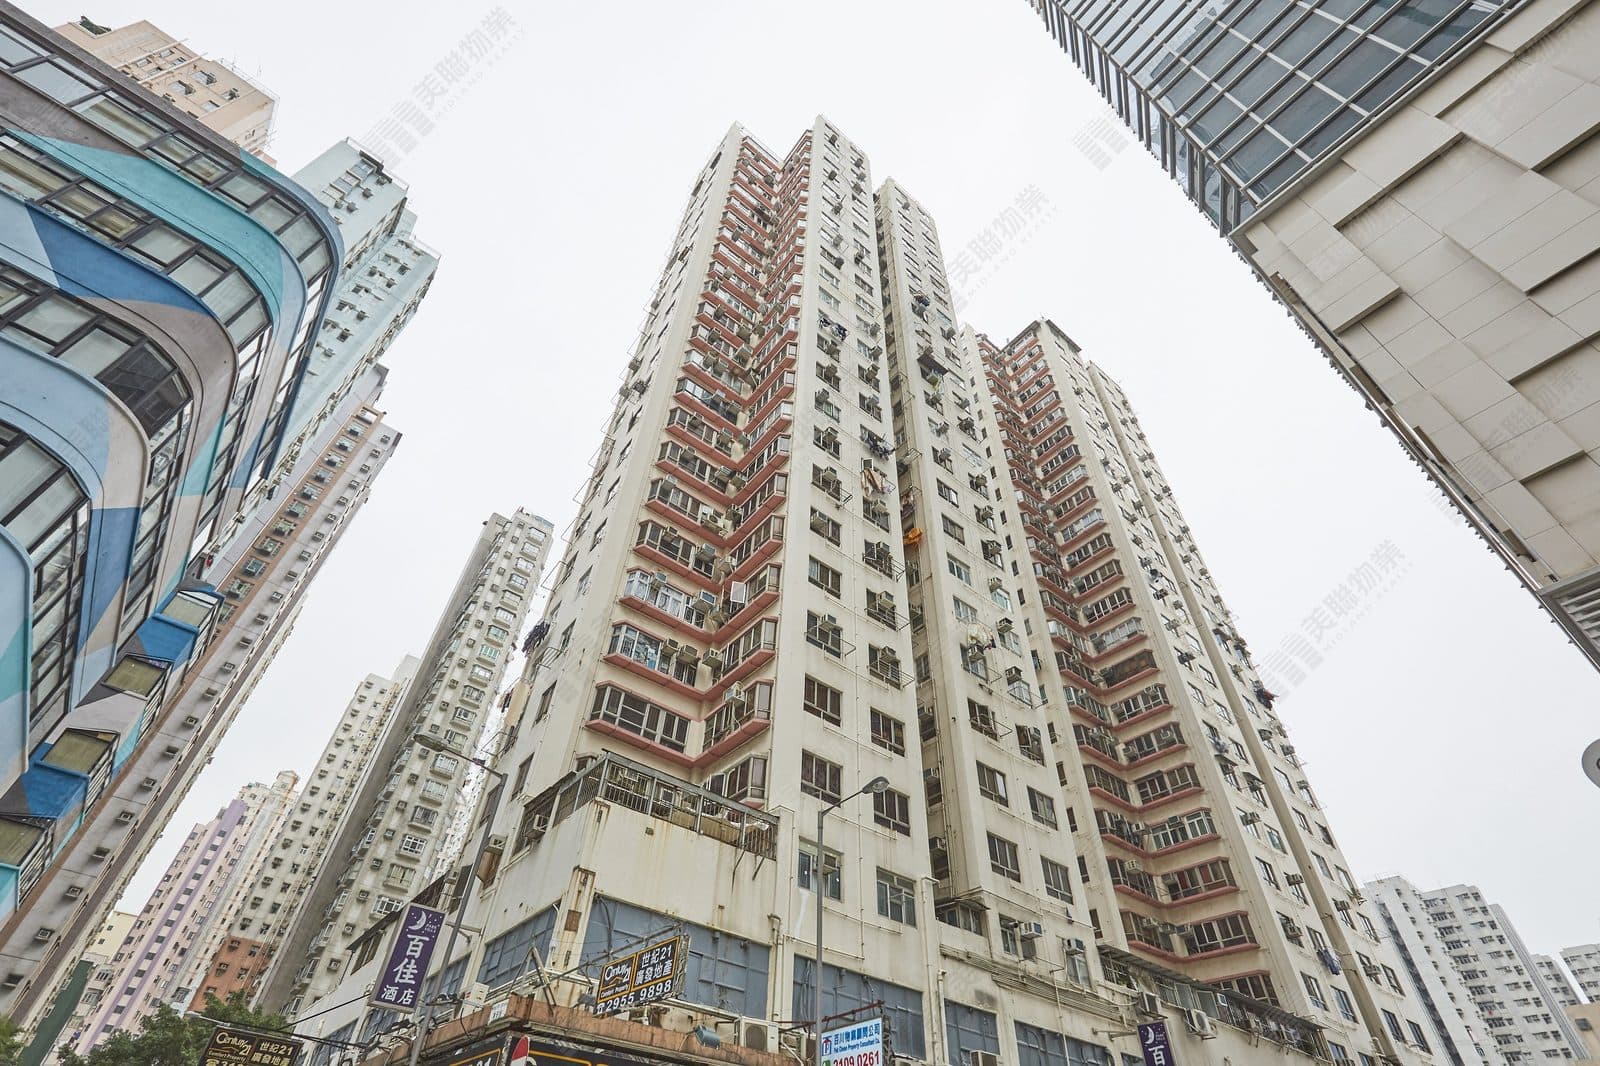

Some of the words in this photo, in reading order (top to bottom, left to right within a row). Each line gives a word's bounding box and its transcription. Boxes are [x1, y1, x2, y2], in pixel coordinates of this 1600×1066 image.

[393, 934, 430, 985] 百佳
[381, 985, 415, 1005] 酒店
[606, 992, 635, 1012] 2955
[640, 979, 672, 1000] 9898
